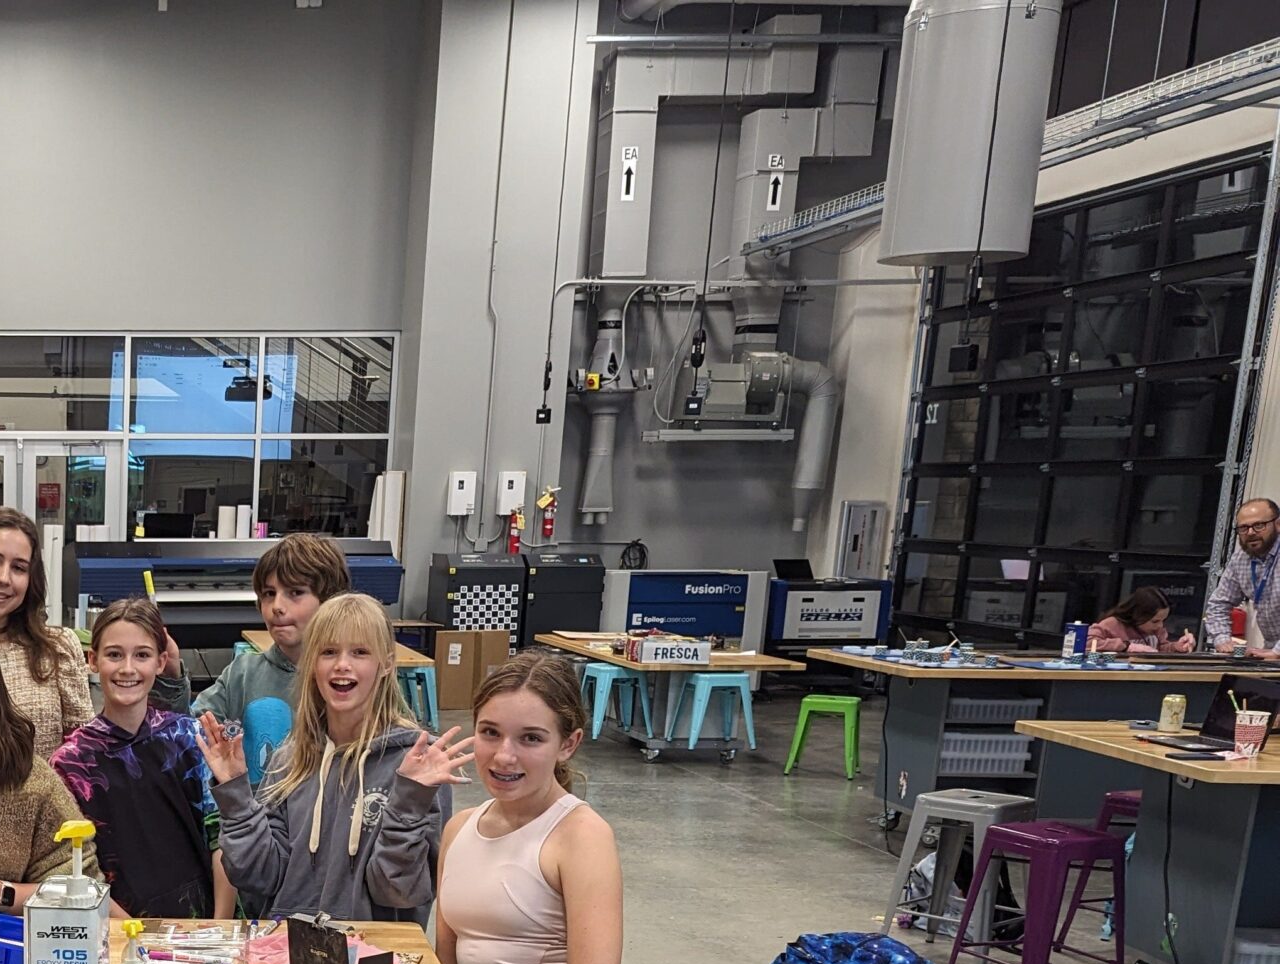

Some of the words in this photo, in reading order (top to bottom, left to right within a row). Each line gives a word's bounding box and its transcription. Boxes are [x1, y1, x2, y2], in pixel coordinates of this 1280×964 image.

[624, 149, 638, 160] EA
[770, 155, 784, 167] EA
[685, 584, 741, 594] FusionPro
[643, 616, 696, 624] EpilogLaser.com
[801, 613, 862, 621] HELIX
[654, 647, 699, 660] FRESCA
[37, 931, 88, 940] SYSTEM
[52, 949, 88, 960] 105
